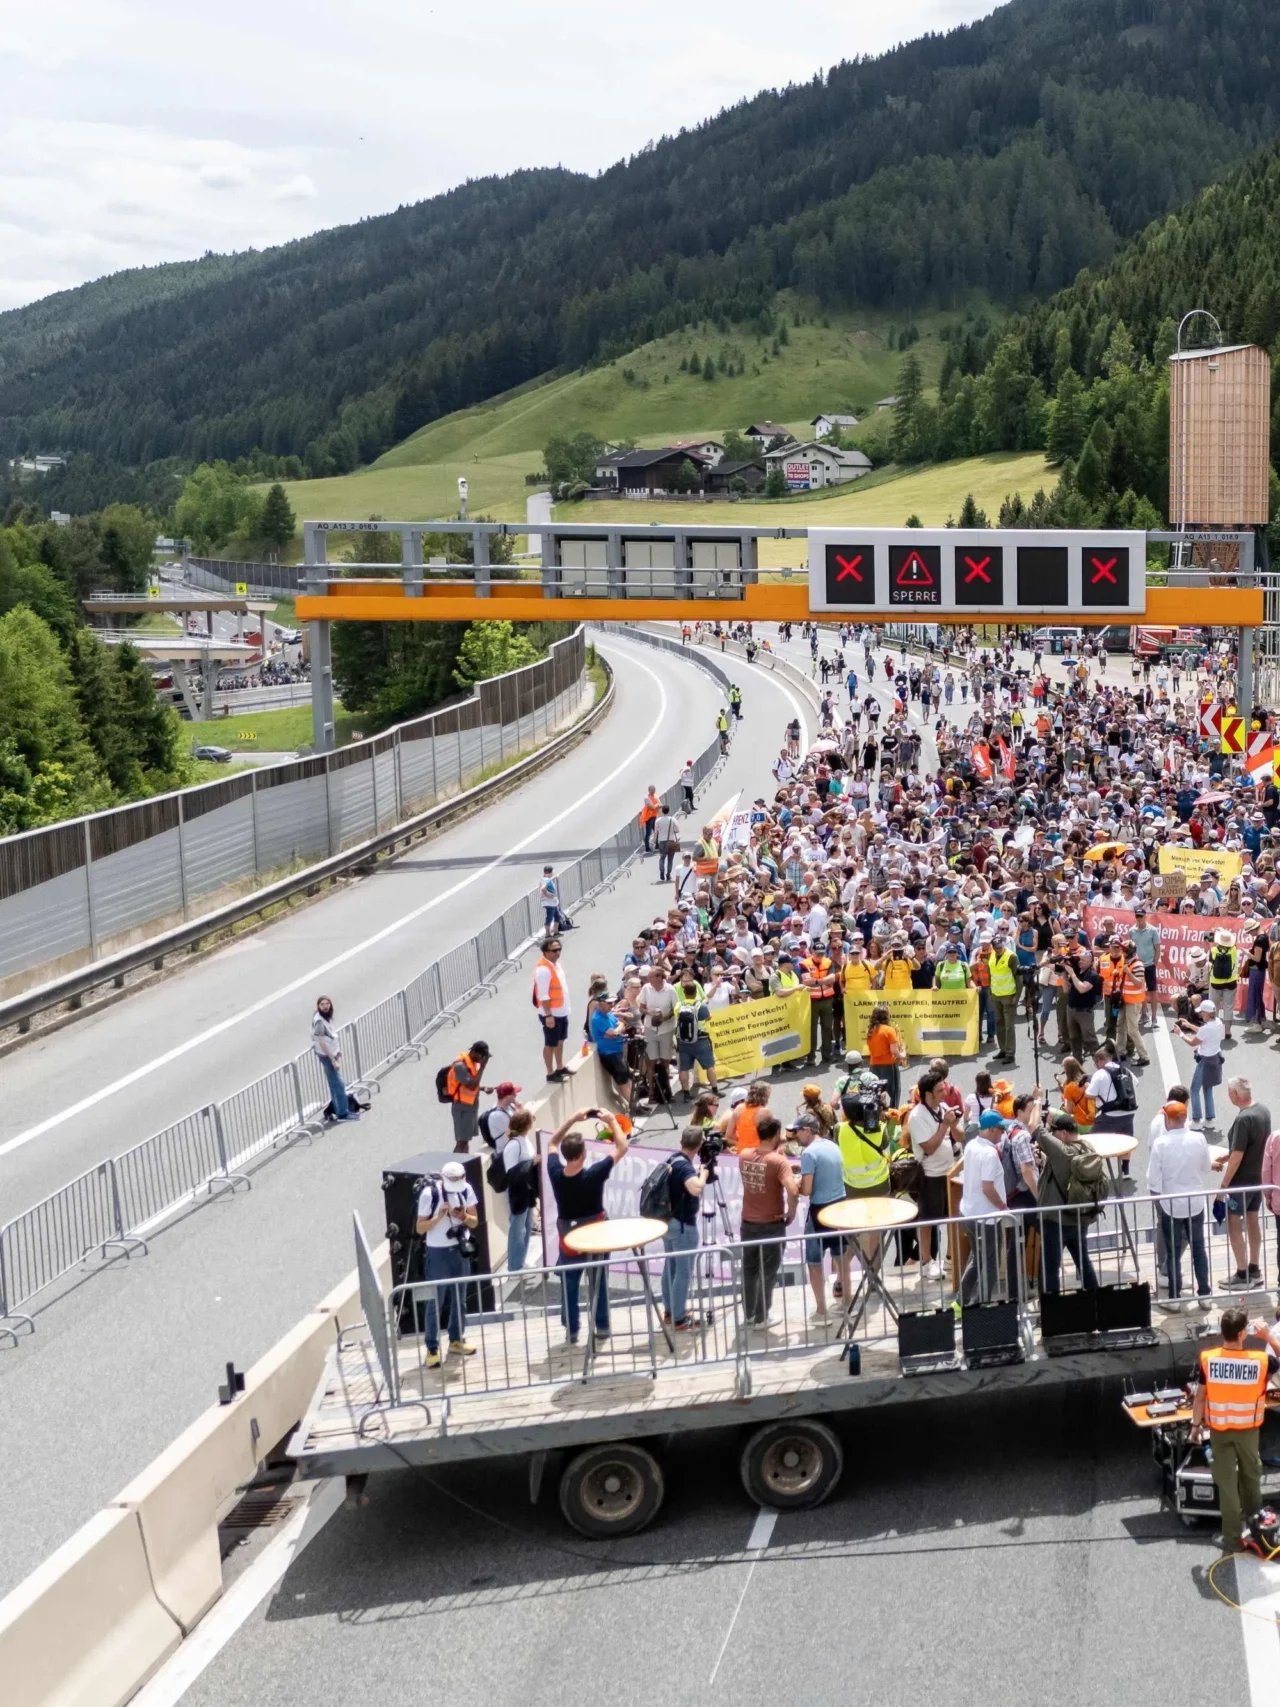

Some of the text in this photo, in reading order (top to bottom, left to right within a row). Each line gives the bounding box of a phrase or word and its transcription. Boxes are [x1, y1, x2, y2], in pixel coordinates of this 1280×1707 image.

[893, 591, 937, 602] SPERRE
[709, 1017, 734, 1028] Mensch
[750, 1003, 788, 1018] Verkehr!
[714, 1024, 790, 1049] Beschleunigungspaket
[716, 1029, 730, 1037] NEIN
[748, 1016, 785, 1030] Fernpass-
[1210, 1362, 1258, 1380] FEUERWEHR
